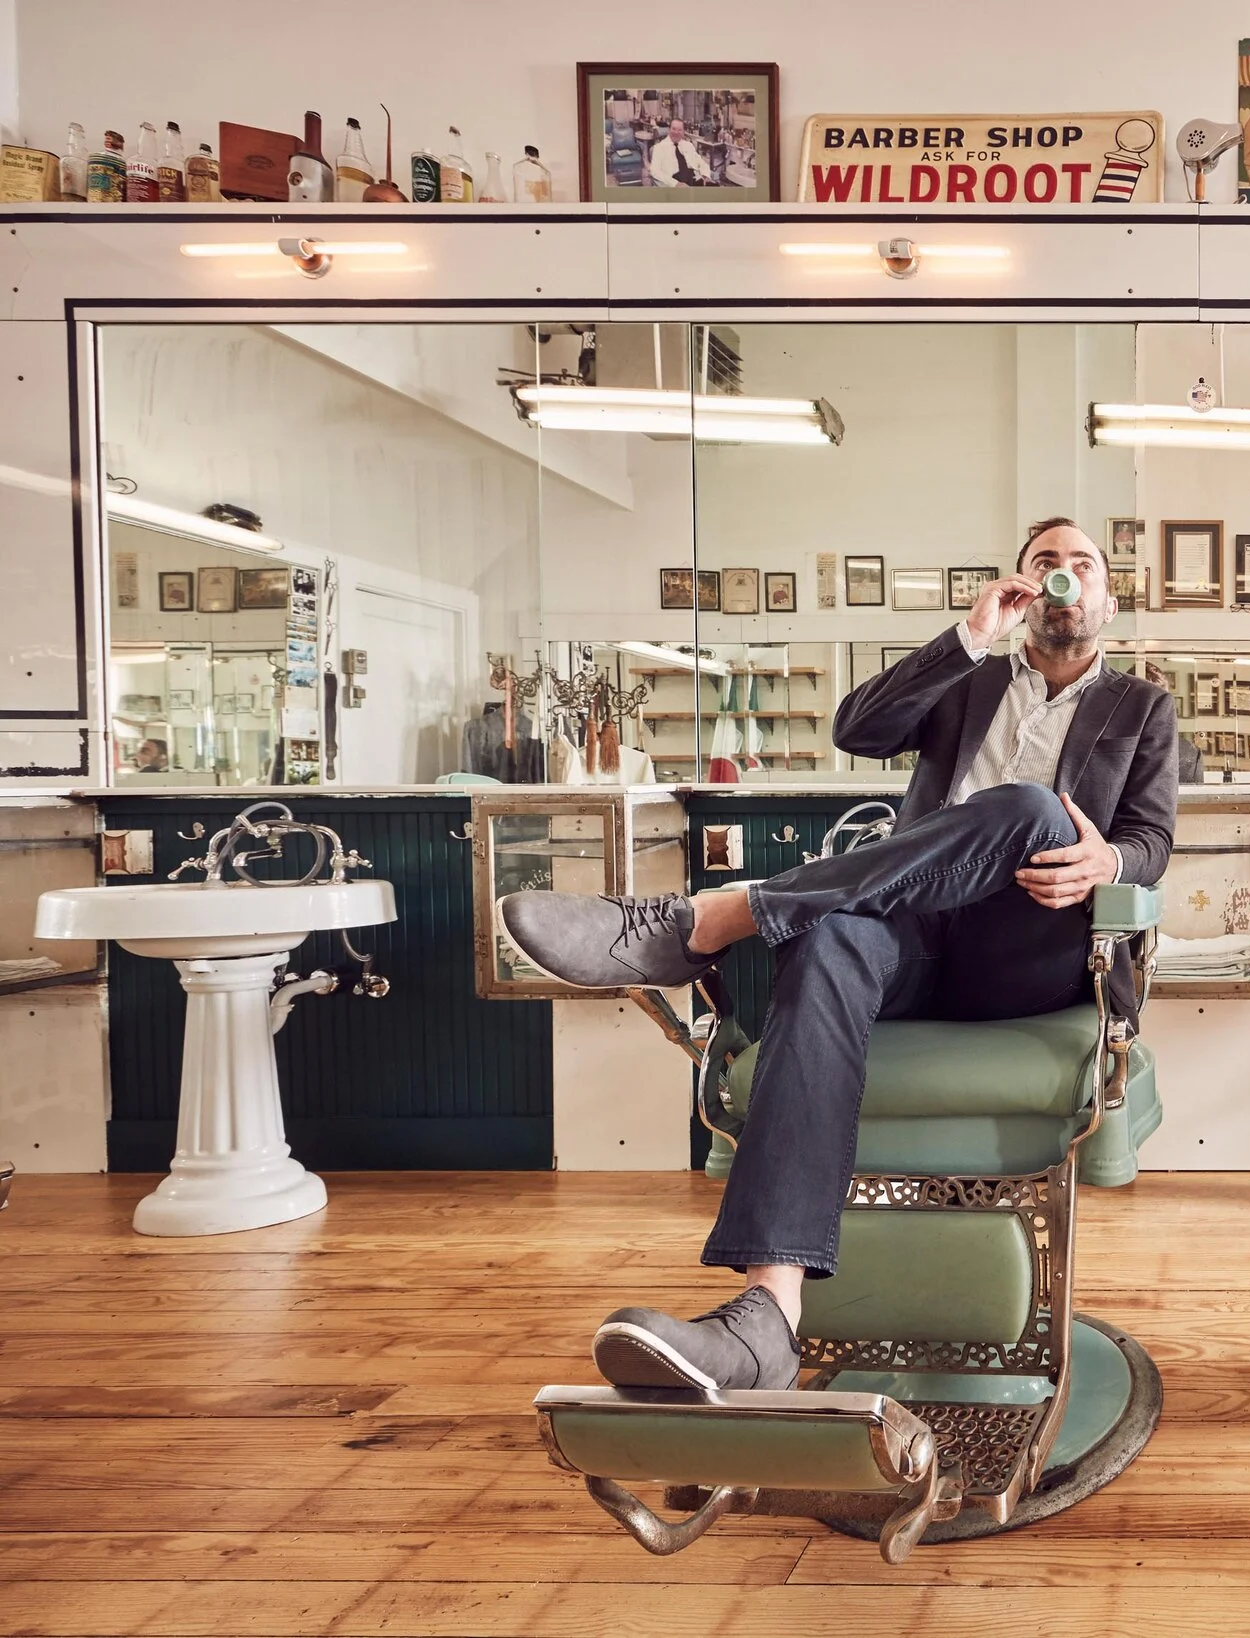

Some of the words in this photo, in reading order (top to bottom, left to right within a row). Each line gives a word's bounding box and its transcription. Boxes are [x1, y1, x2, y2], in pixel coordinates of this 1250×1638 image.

[823, 127, 966, 149] BARBER
[987, 126, 1084, 148] SHOP
[921, 151, 955, 161] ASK
[966, 151, 1001, 161] FOR
[811, 163, 1092, 203] WILDROOT
